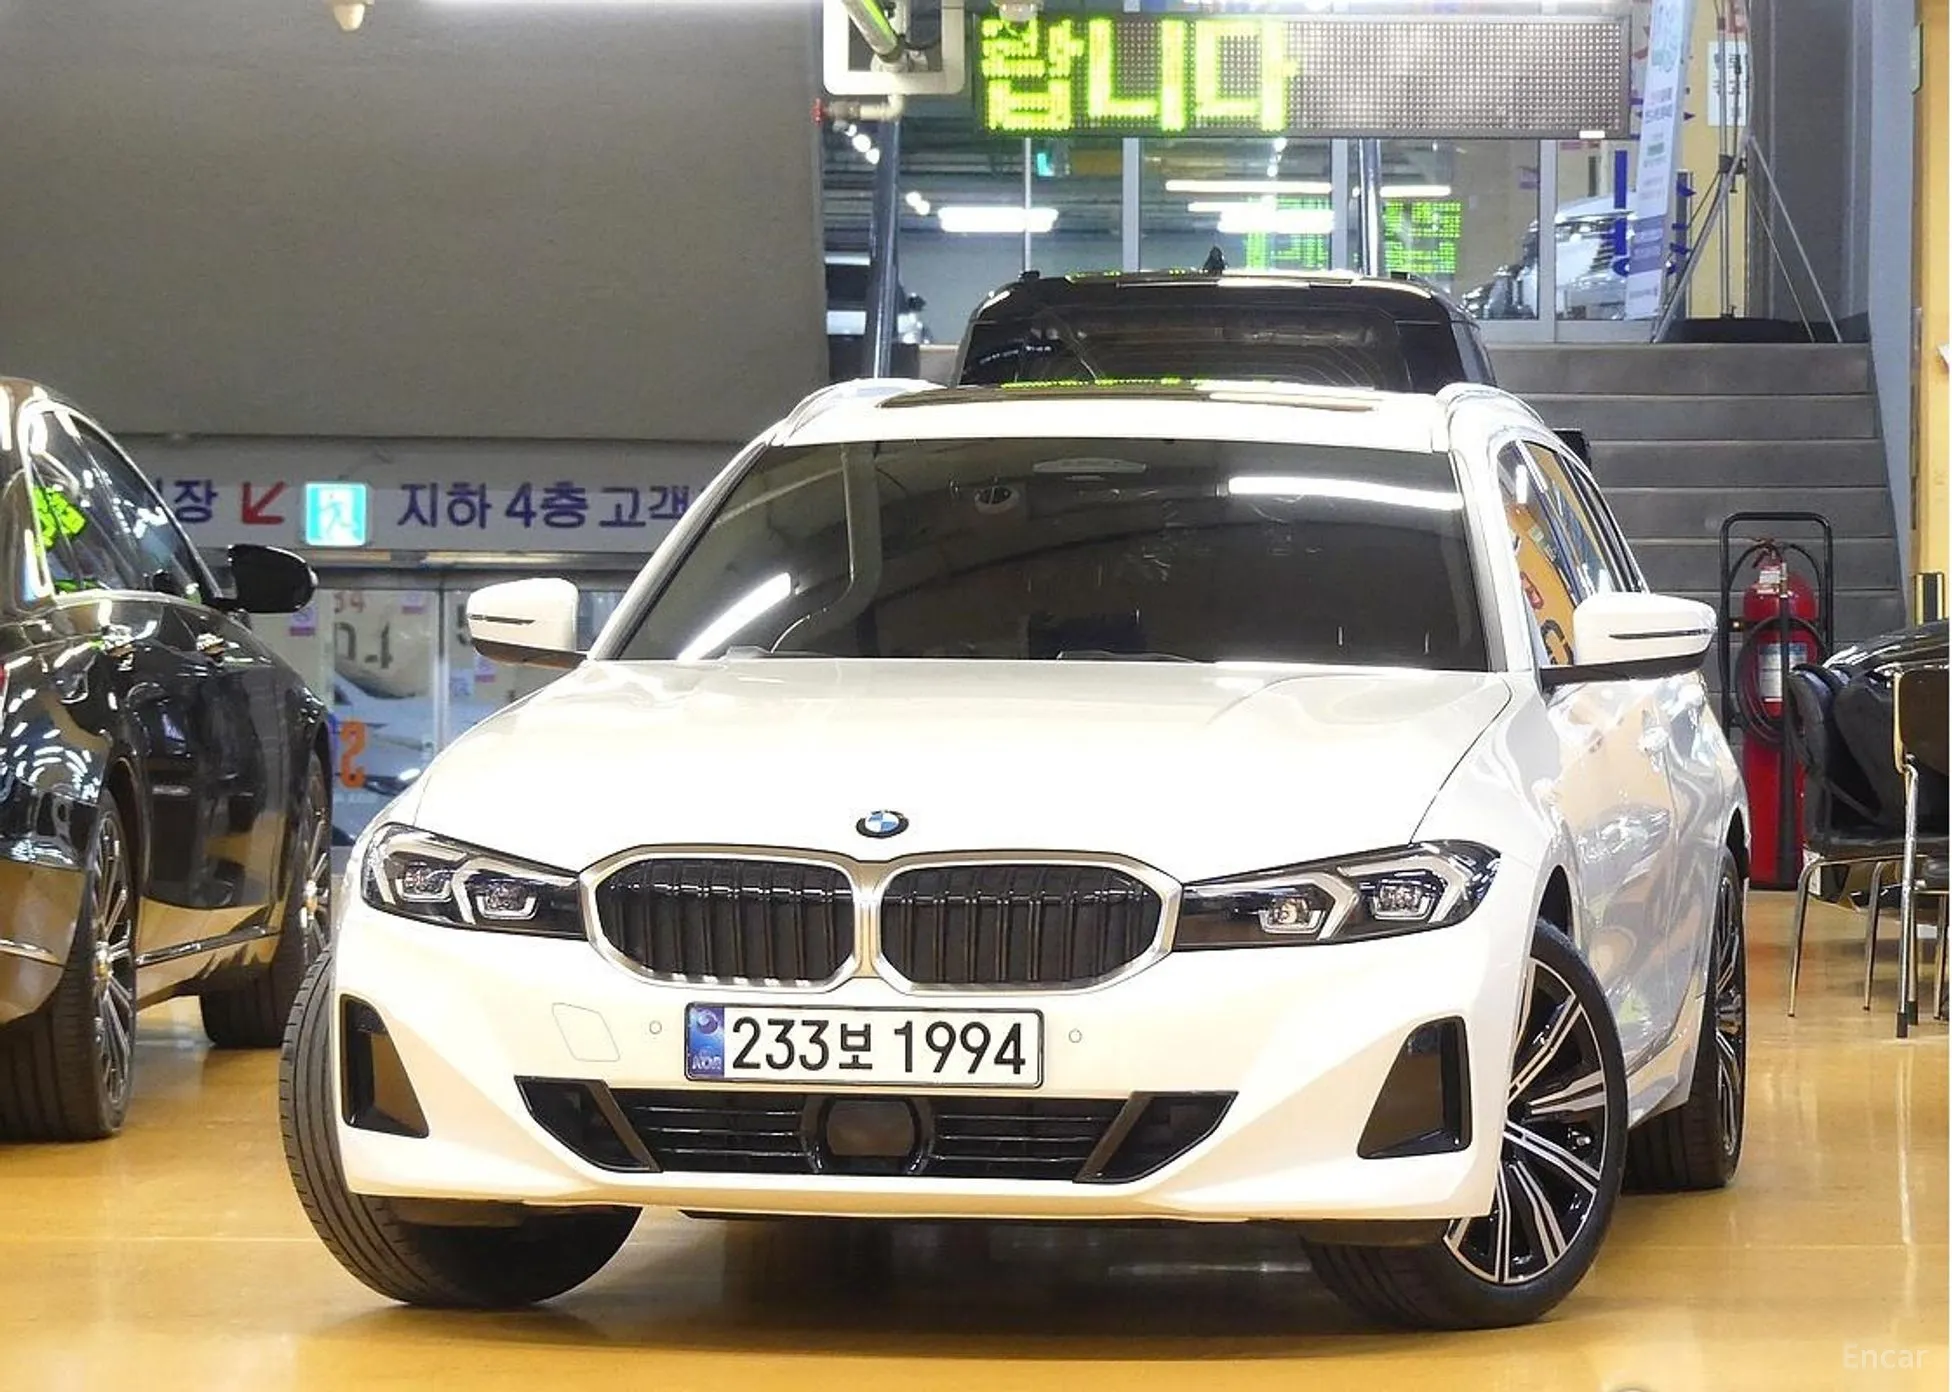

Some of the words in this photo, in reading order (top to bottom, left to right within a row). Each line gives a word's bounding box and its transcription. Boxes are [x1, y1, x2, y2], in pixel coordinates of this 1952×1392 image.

[156, 478, 218, 524] 장
[397, 482, 492, 529] 지하
[505, 481, 590, 529] 4층
[598, 484, 704, 528] 고객
[732, 1016, 873, 1071] 233보
[894, 1020, 1026, 1075] 1994
